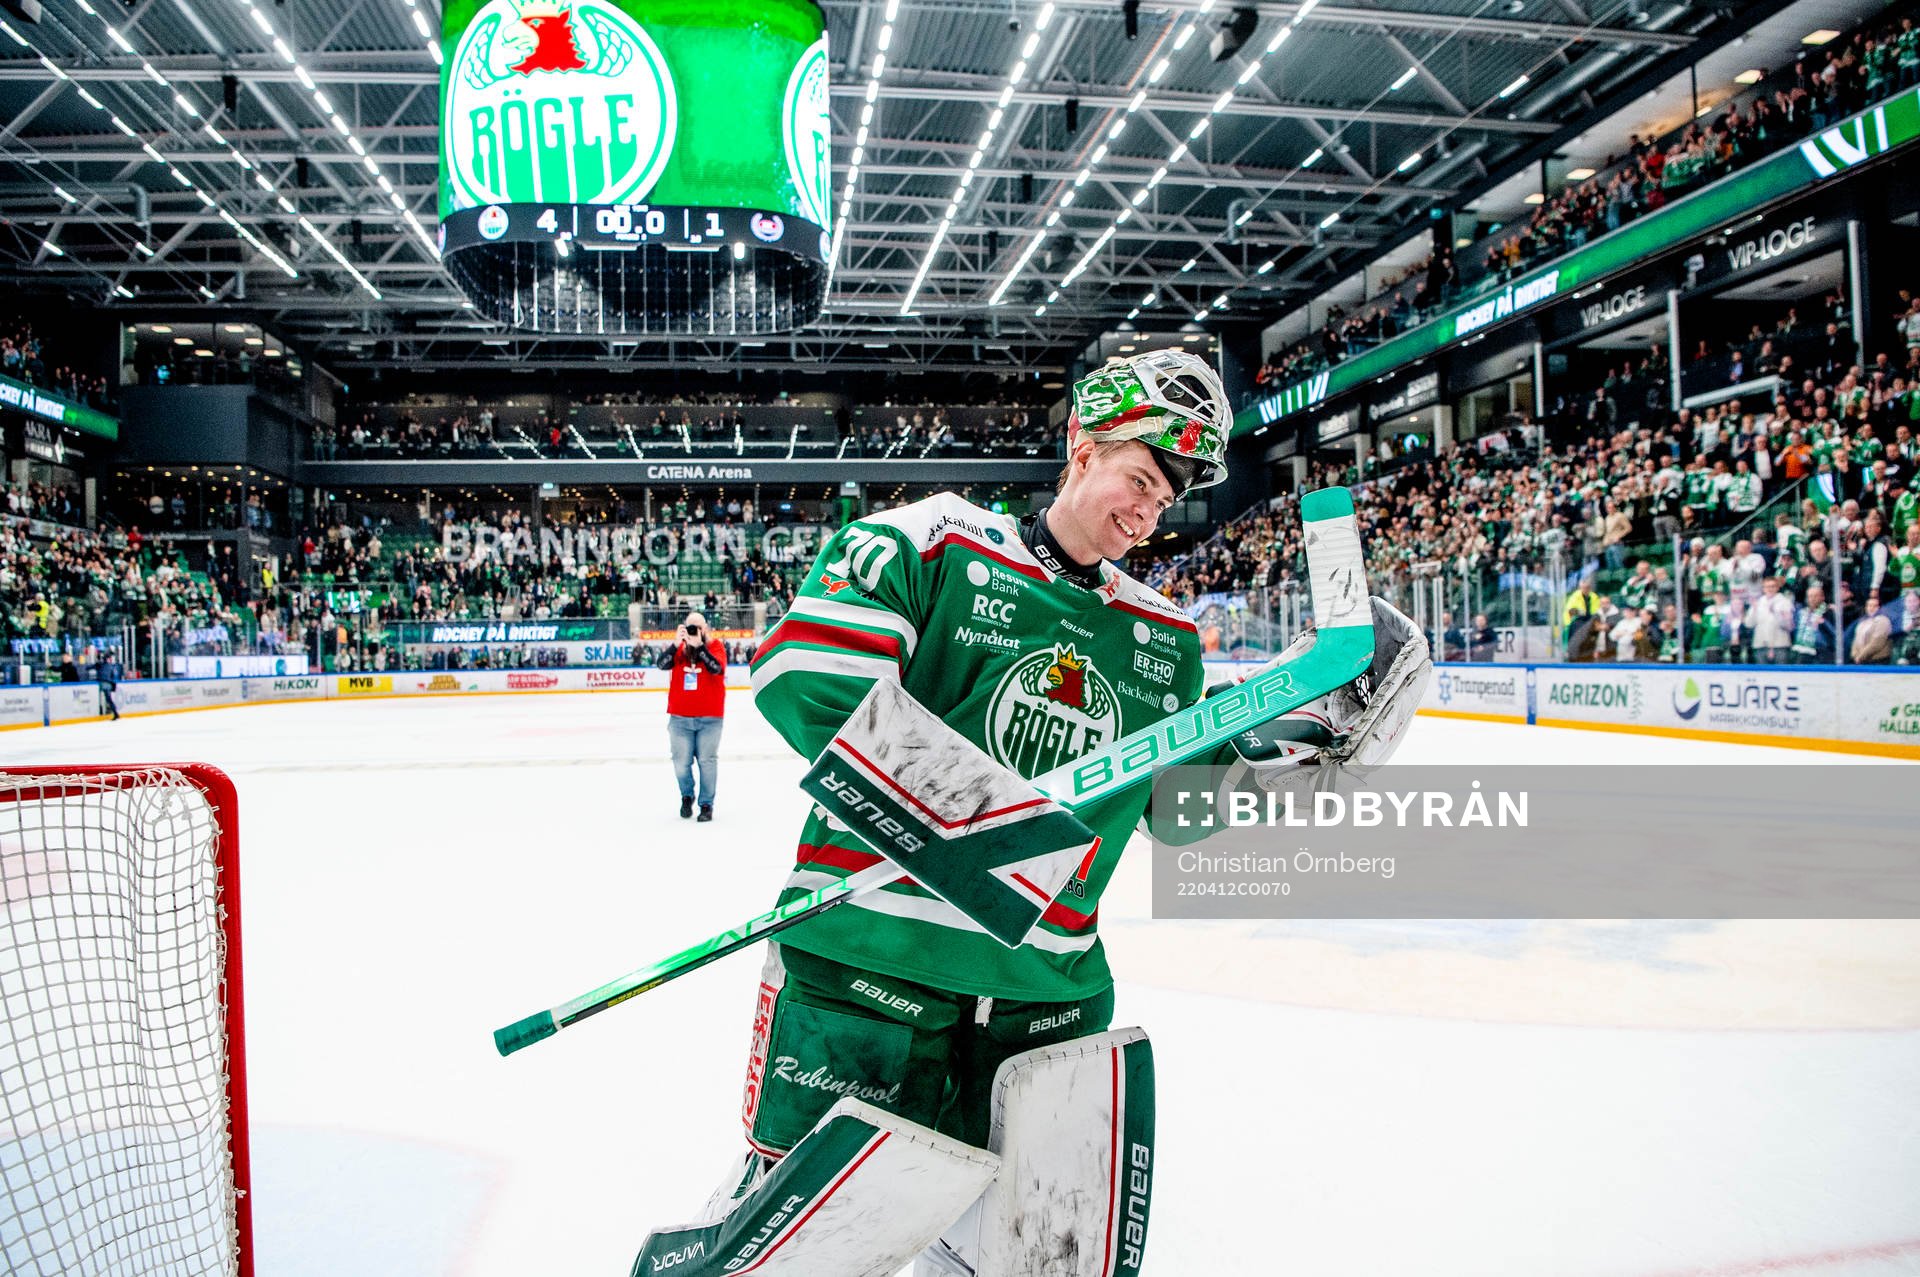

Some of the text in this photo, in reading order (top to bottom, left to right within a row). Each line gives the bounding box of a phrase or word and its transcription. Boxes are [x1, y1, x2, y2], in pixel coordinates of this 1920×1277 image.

[469, 88, 637, 203] RÖGLE
[537, 208, 558, 233] 4
[705, 212, 725, 237] 1
[1727, 216, 1817, 272] VIP-LOGE
[1579, 285, 1646, 328] VIP-LOGE
[647, 465, 752, 479] CATENA Arena
[825, 526, 899, 593] 70
[991, 566, 1030, 589] Resurs
[991, 578, 1020, 598] Bank
[972, 593, 1017, 624] RCC
[433, 626, 485, 643] HOCKEY
[486, 623, 507, 642] PÅ
[508, 626, 559, 641] RIKTIGT
[954, 626, 1021, 650] Nymålat
[1060, 618, 1095, 640] BAUER
[1151, 627, 1177, 647] Solid
[585, 643, 633, 661] SKÅNE
[1150, 640, 1182, 662] Försäkring
[587, 671, 646, 681] FLYTGOLV
[1136, 654, 1172, 679] ER-HO
[1142, 670, 1163, 684] BYGG
[273, 678, 319, 691] HiKOKI
[349, 677, 373, 688] MVB
[1117, 680, 1161, 709] Backahill
[1548, 683, 1628, 707] AGRIZON
[1709, 678, 1800, 711] BJÄRE
[1072, 670, 1299, 797] BAUER
[1709, 714, 1801, 729] MARKKONSULT
[1002, 700, 1103, 781] RÖGLE
[819, 771, 925, 853] BAUER
[850, 979, 924, 1017] BAUER
[1028, 1007, 1081, 1034] BAUER
[771, 1055, 902, 1104] Rubinpool
[1122, 1142, 1150, 1269] BAUER
[723, 1194, 805, 1271] BAUER
[651, 1241, 705, 1272] VAPOR
